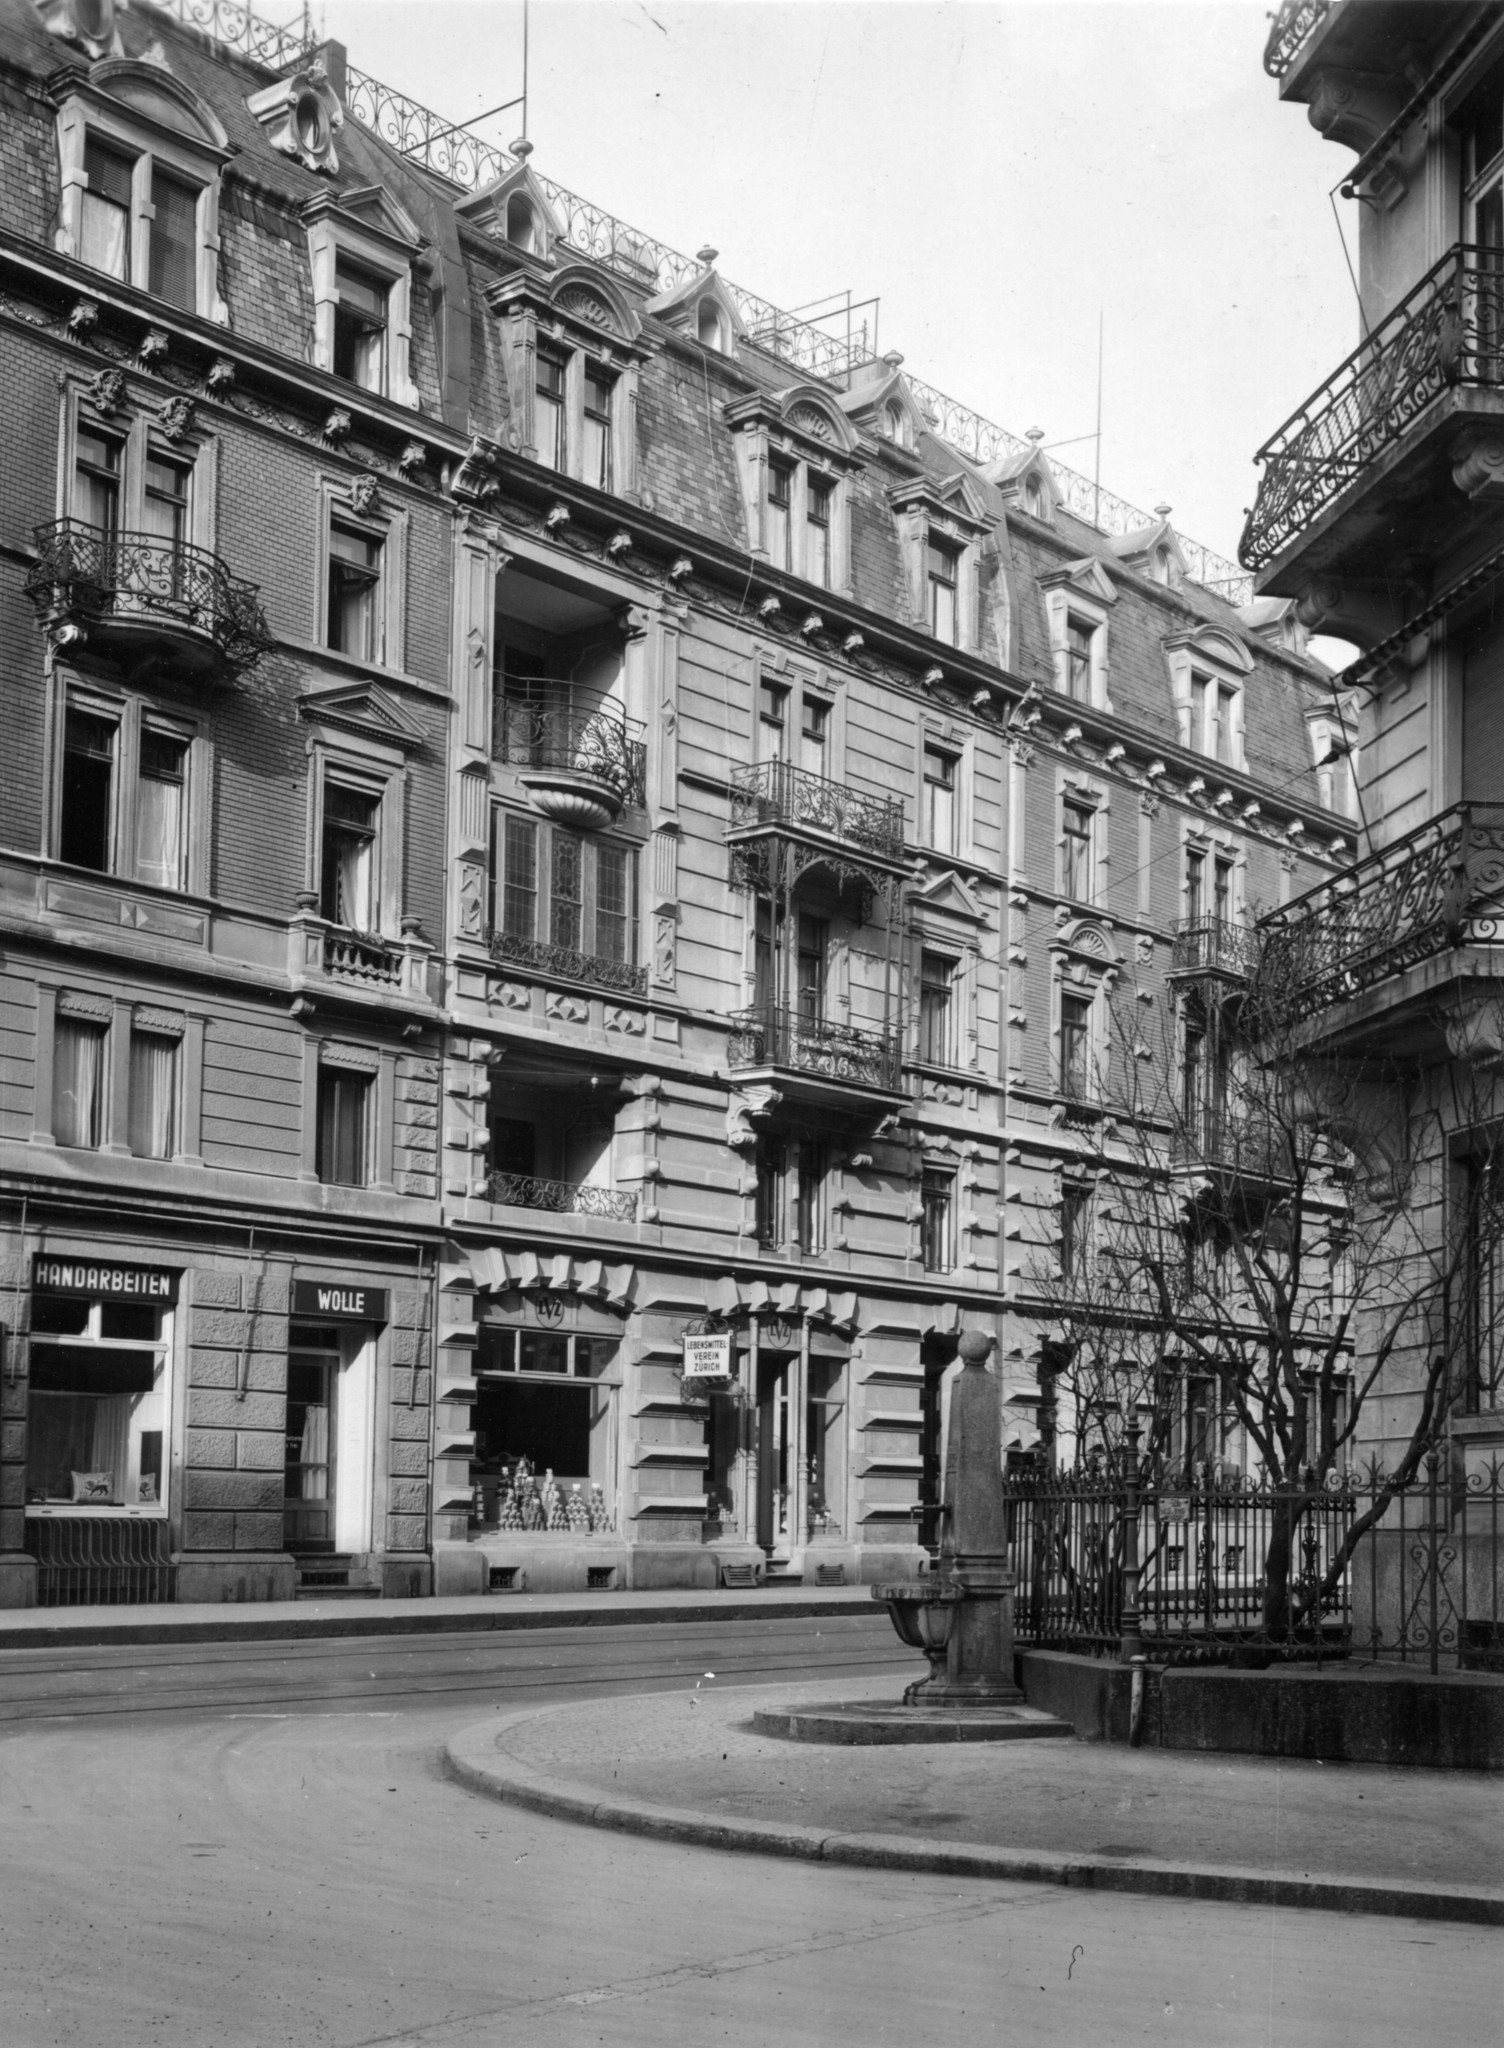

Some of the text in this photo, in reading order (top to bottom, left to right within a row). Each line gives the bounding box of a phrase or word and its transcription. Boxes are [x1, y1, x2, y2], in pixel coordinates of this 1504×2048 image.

[36, 1263, 170, 1295] HANDARBEITEN
[318, 1289, 365, 1313] WOLLE
[538, 1296, 562, 1320] LVZ
[769, 1319, 790, 1341] LVZ
[687, 1340, 728, 1350] LEBENSMITTEL-
[694, 1352, 720, 1360] VEREIN
[694, 1361, 720, 1372] ZÜRICH
